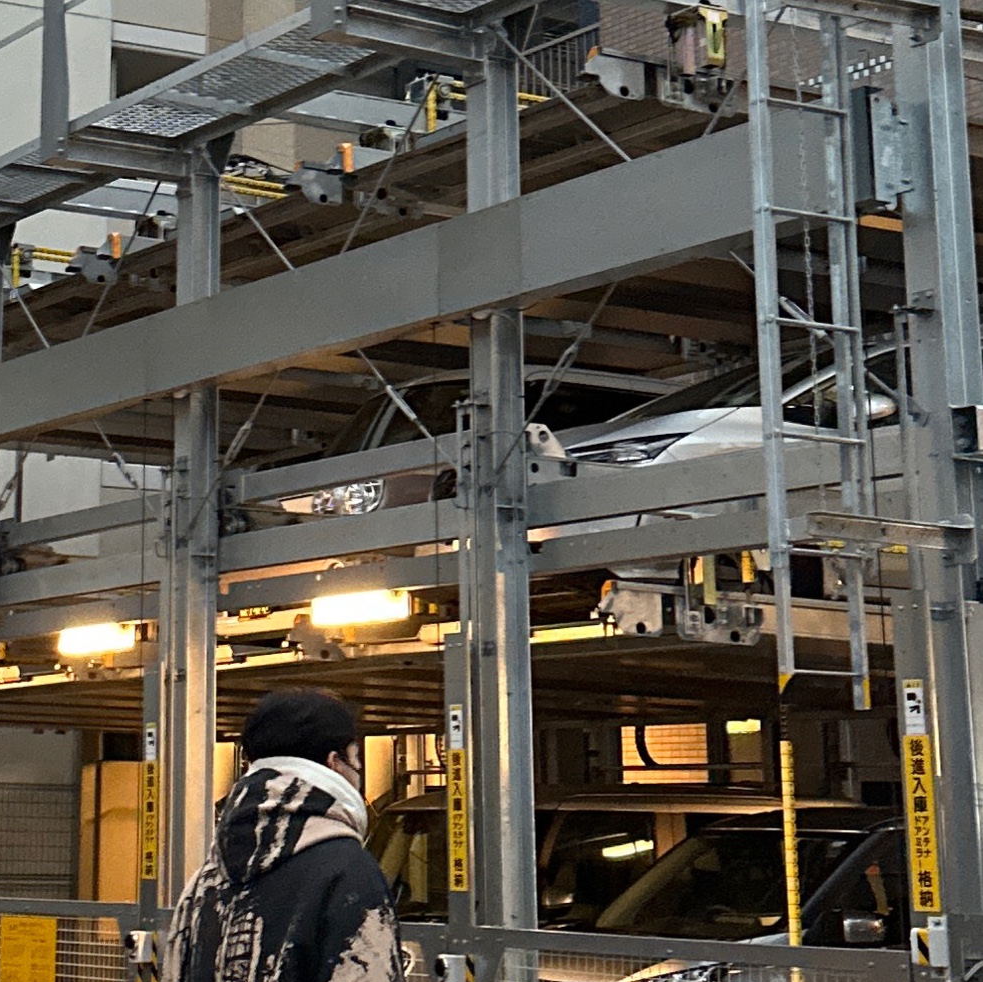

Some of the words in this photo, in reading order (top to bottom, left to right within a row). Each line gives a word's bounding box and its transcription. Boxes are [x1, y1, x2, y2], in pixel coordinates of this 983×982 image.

[909, 738, 929, 813] 後進入庫
[918, 870, 934, 908] 格納
